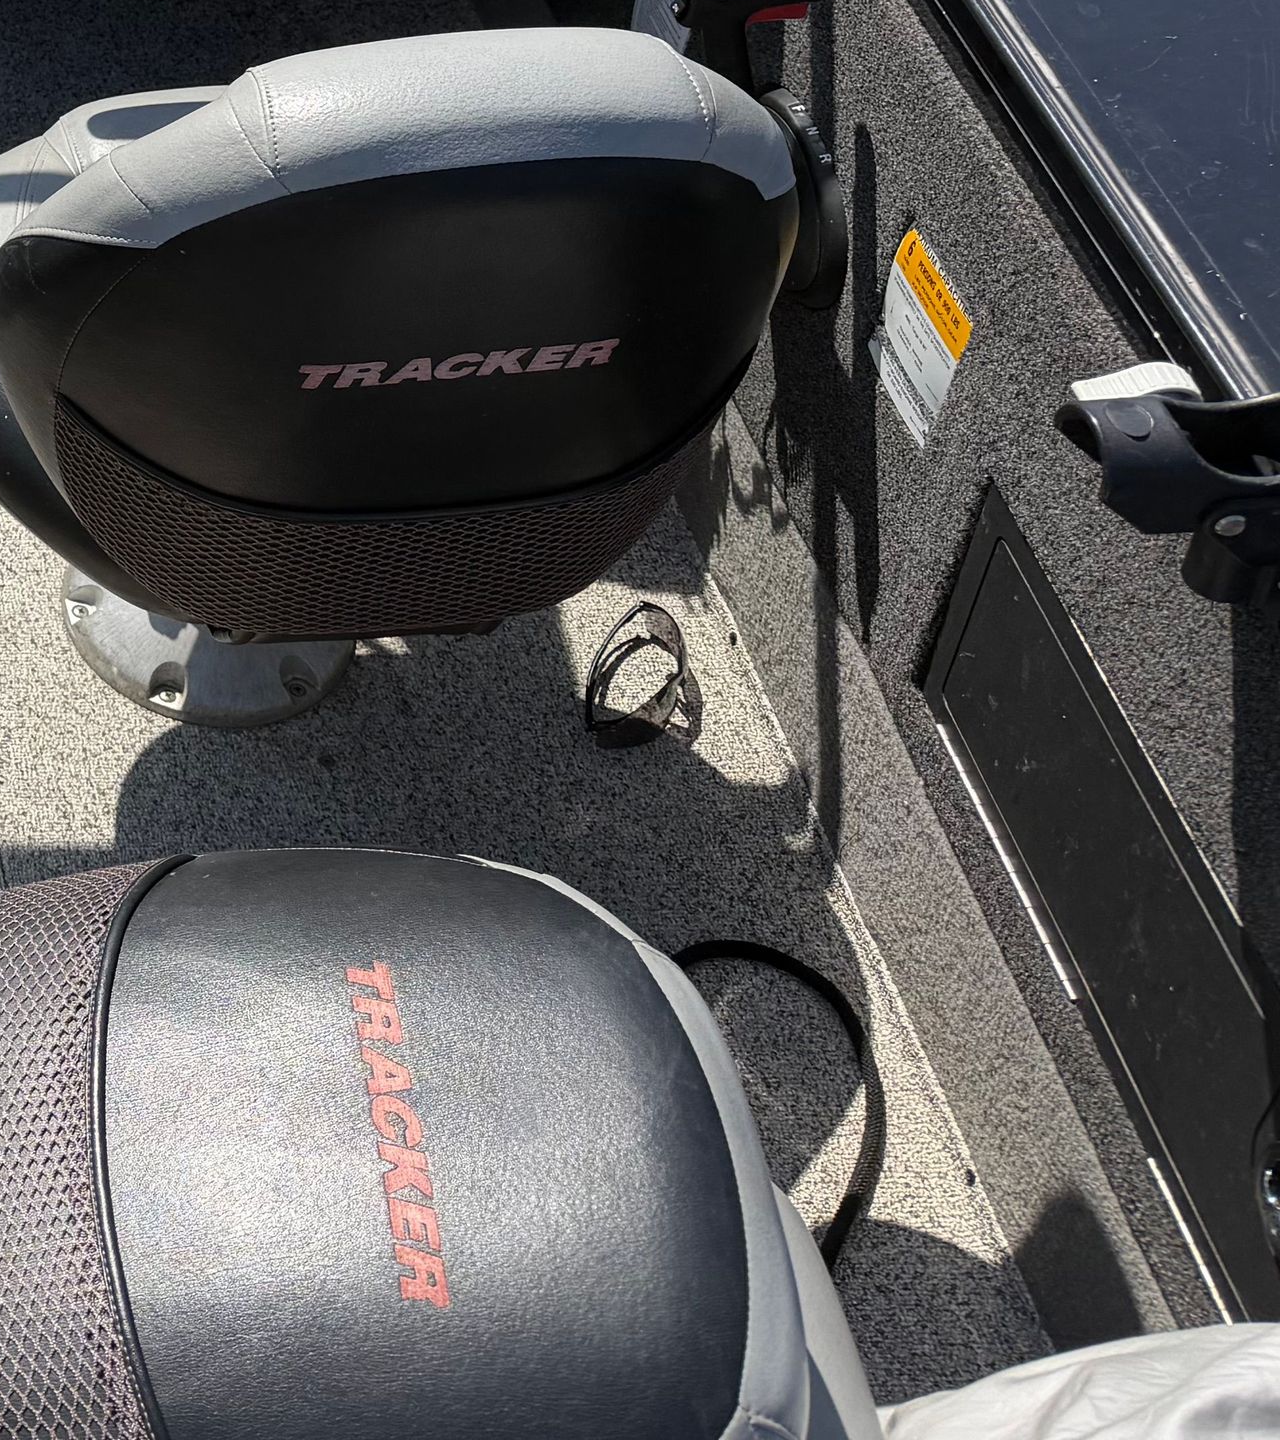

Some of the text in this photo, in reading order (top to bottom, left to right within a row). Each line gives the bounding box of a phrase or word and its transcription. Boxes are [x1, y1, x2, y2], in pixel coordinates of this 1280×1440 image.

[907, 241, 916, 257] 6
[918, 260, 937, 290] PERSONS
[950, 313, 960, 330] LBS
[298, 338, 620, 389] TRACKER
[345, 960, 451, 1308] TRACKER
